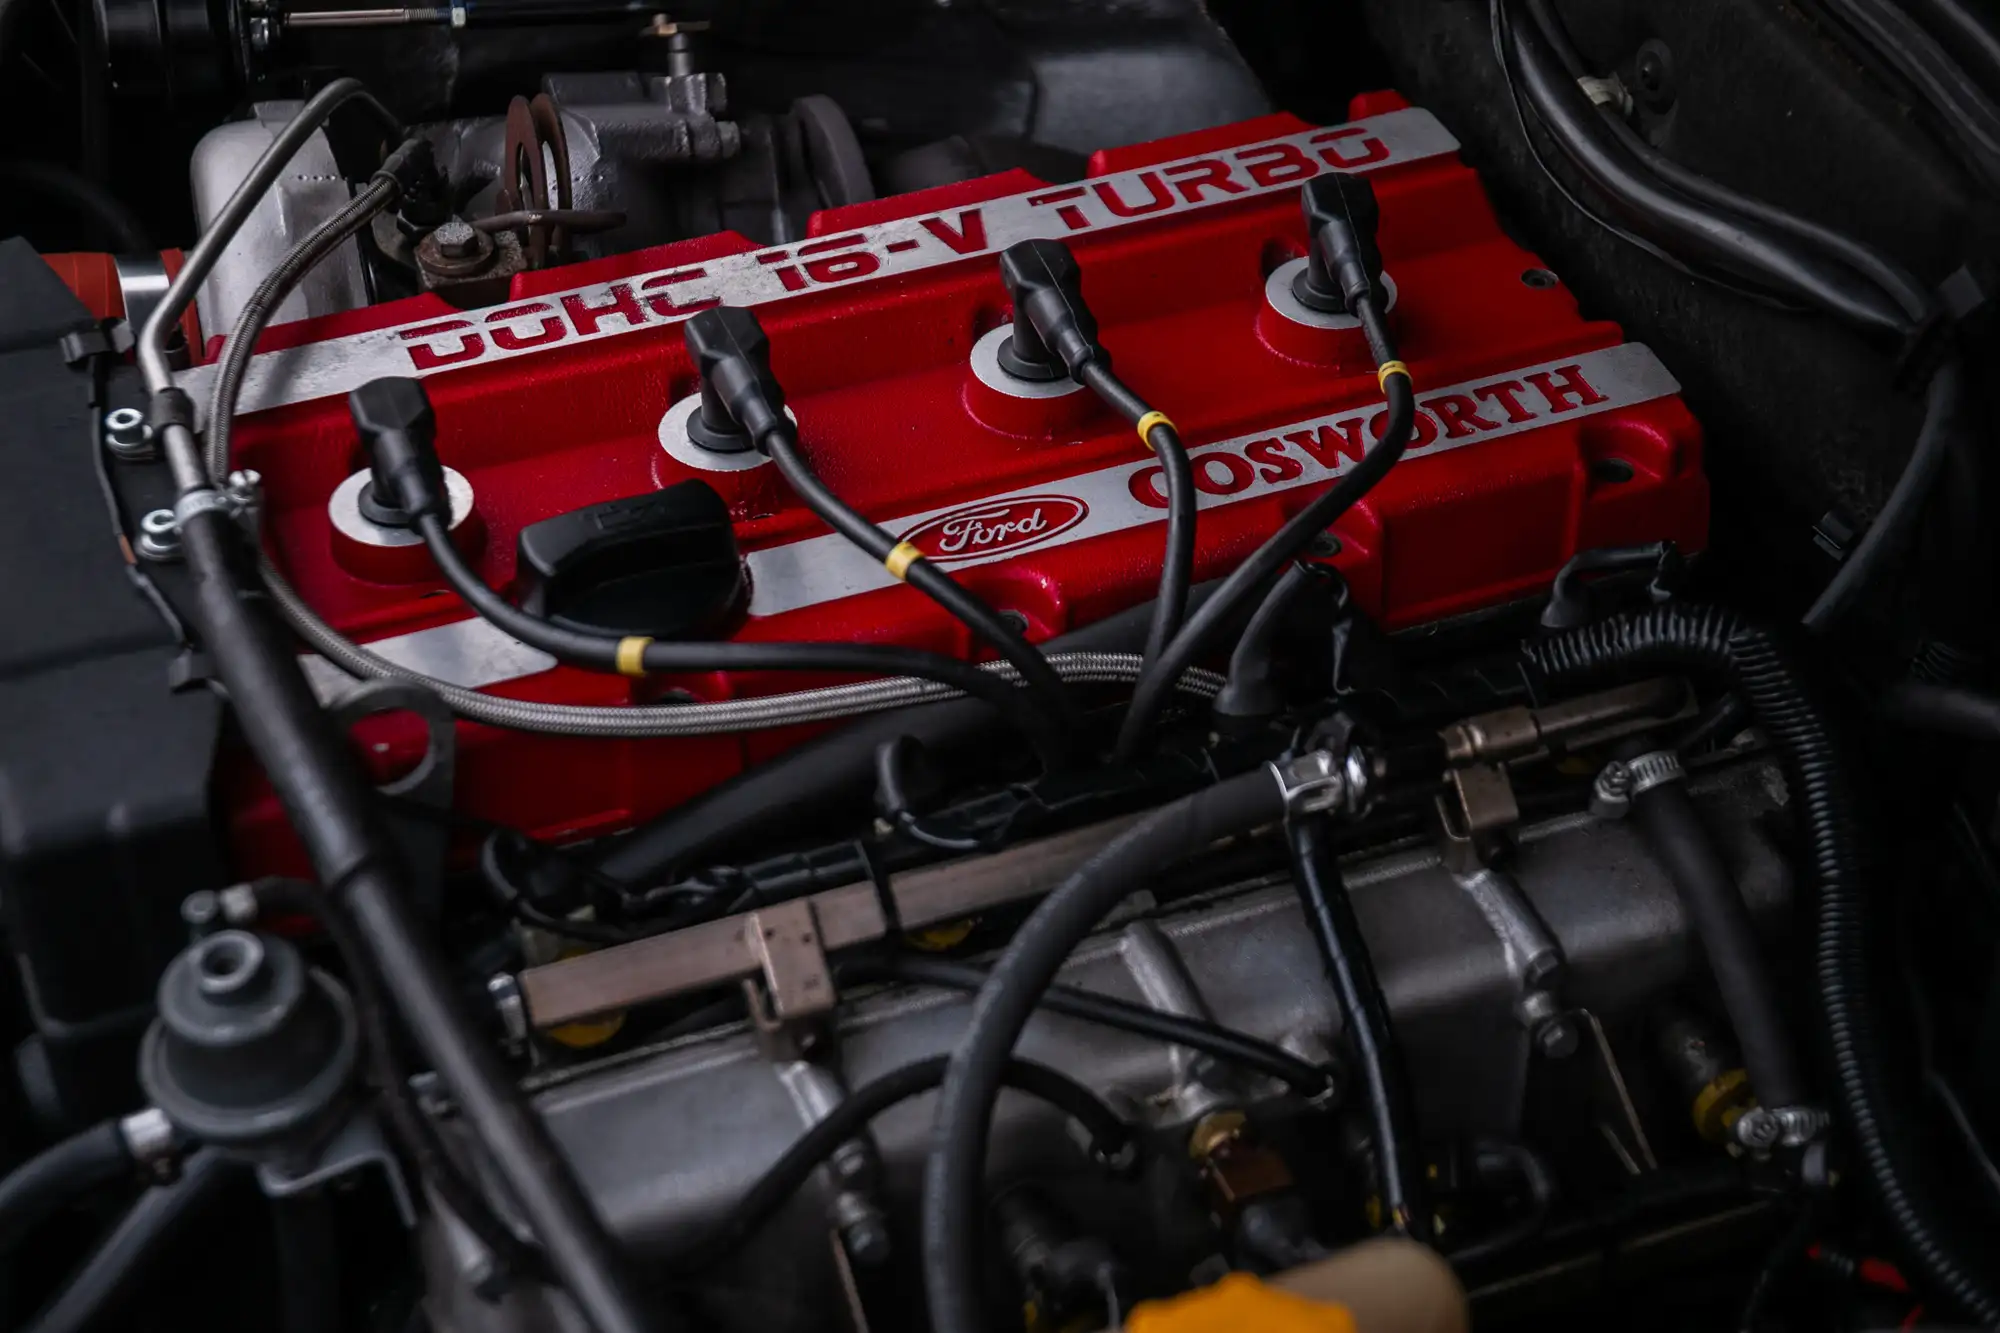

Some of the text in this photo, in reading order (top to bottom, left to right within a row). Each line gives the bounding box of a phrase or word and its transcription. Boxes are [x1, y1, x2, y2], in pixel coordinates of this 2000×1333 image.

[399, 127, 1390, 371] DOHC 16-V TURBO
[939, 508, 1048, 552] Ford
